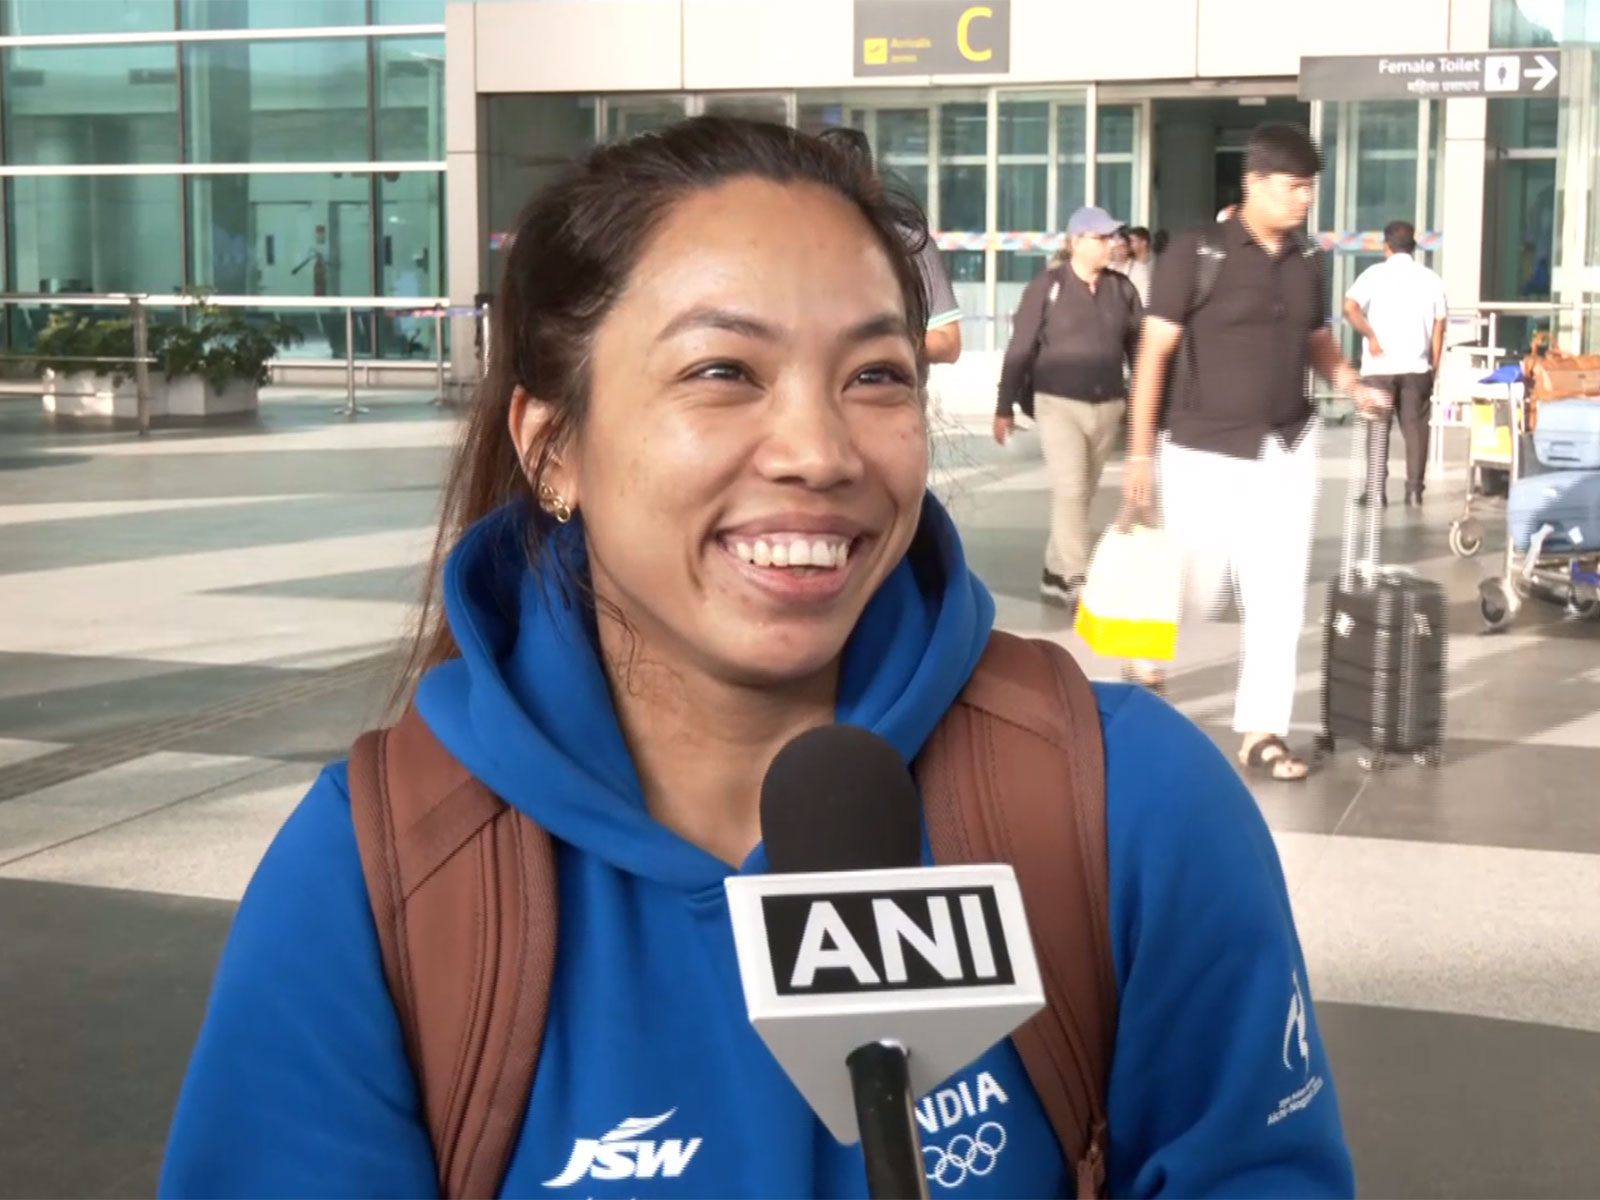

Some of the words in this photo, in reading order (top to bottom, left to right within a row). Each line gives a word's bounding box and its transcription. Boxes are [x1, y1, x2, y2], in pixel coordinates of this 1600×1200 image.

[956, 6, 993, 62] C
[1378, 58, 1435, 74] Female
[1438, 56, 1480, 72] Toilet
[789, 894, 998, 988] ANI
[914, 1071, 1010, 1133] NDIA
[540, 1137, 703, 1188] JSW
